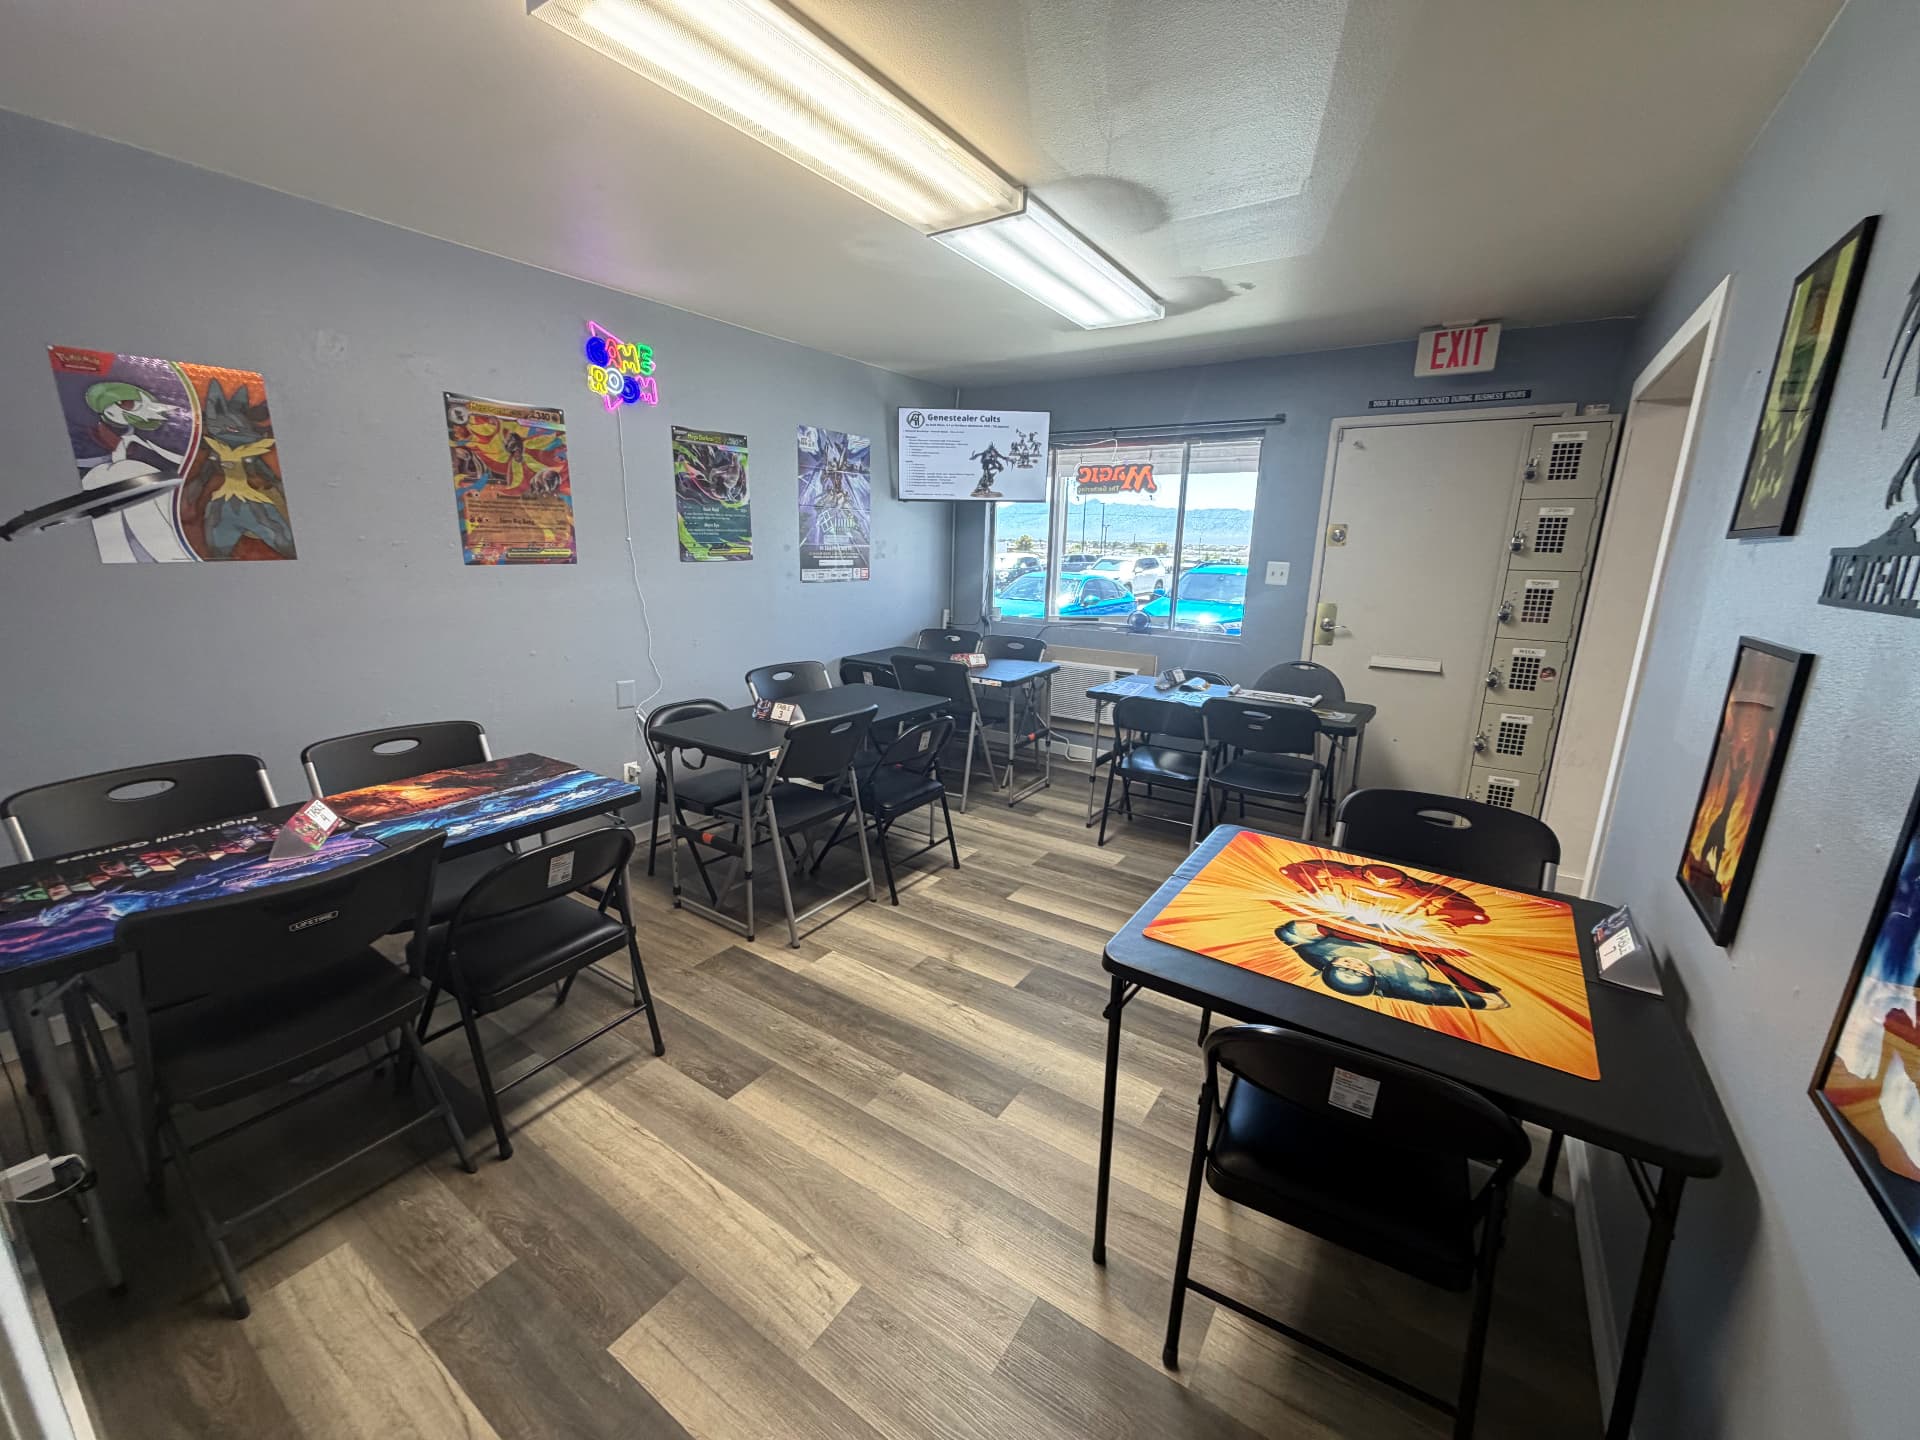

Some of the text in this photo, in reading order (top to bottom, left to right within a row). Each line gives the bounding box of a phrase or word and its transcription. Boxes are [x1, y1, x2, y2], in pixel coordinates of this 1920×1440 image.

[586, 336, 653, 375] GAME
[1430, 326, 1489, 370] EXIT
[588, 365, 658, 406] ROOM
[1420, 397, 1450, 405] UNLOCKED
[1451, 395, 1473, 403] DURING
[1474, 393, 1504, 401] BUSINESS
[1505, 391, 1527, 399] HOURS
[927, 414, 1001, 423] Genestealer Cults
[778, 710, 784, 719] 3
[56, 816, 258, 864] Nightfall Games
